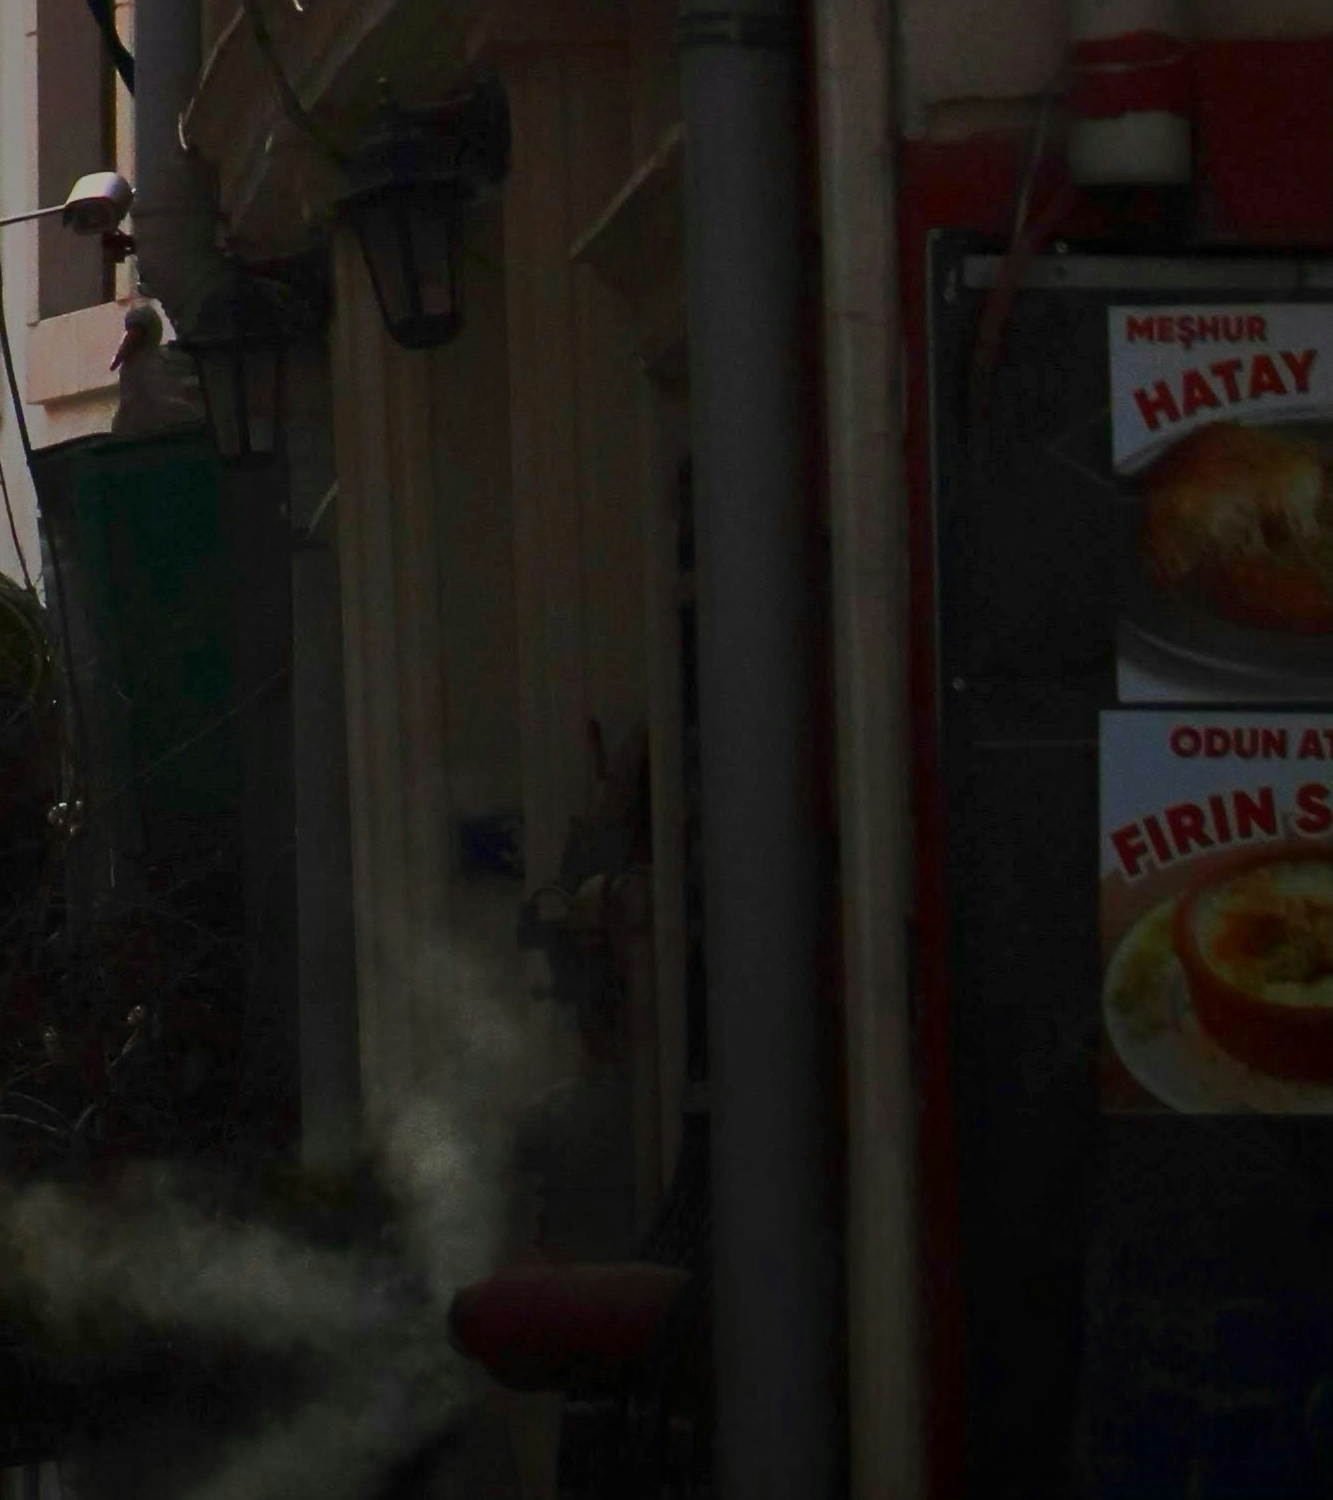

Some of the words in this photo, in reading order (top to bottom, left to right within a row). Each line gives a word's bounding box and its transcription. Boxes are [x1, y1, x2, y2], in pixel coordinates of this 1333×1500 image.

[1125, 314, 1268, 349] MEŞHUR
[1133, 348, 1317, 430] HATAY
[1169, 726, 1288, 759] ODUN
[1110, 786, 1278, 877] FIRIN
